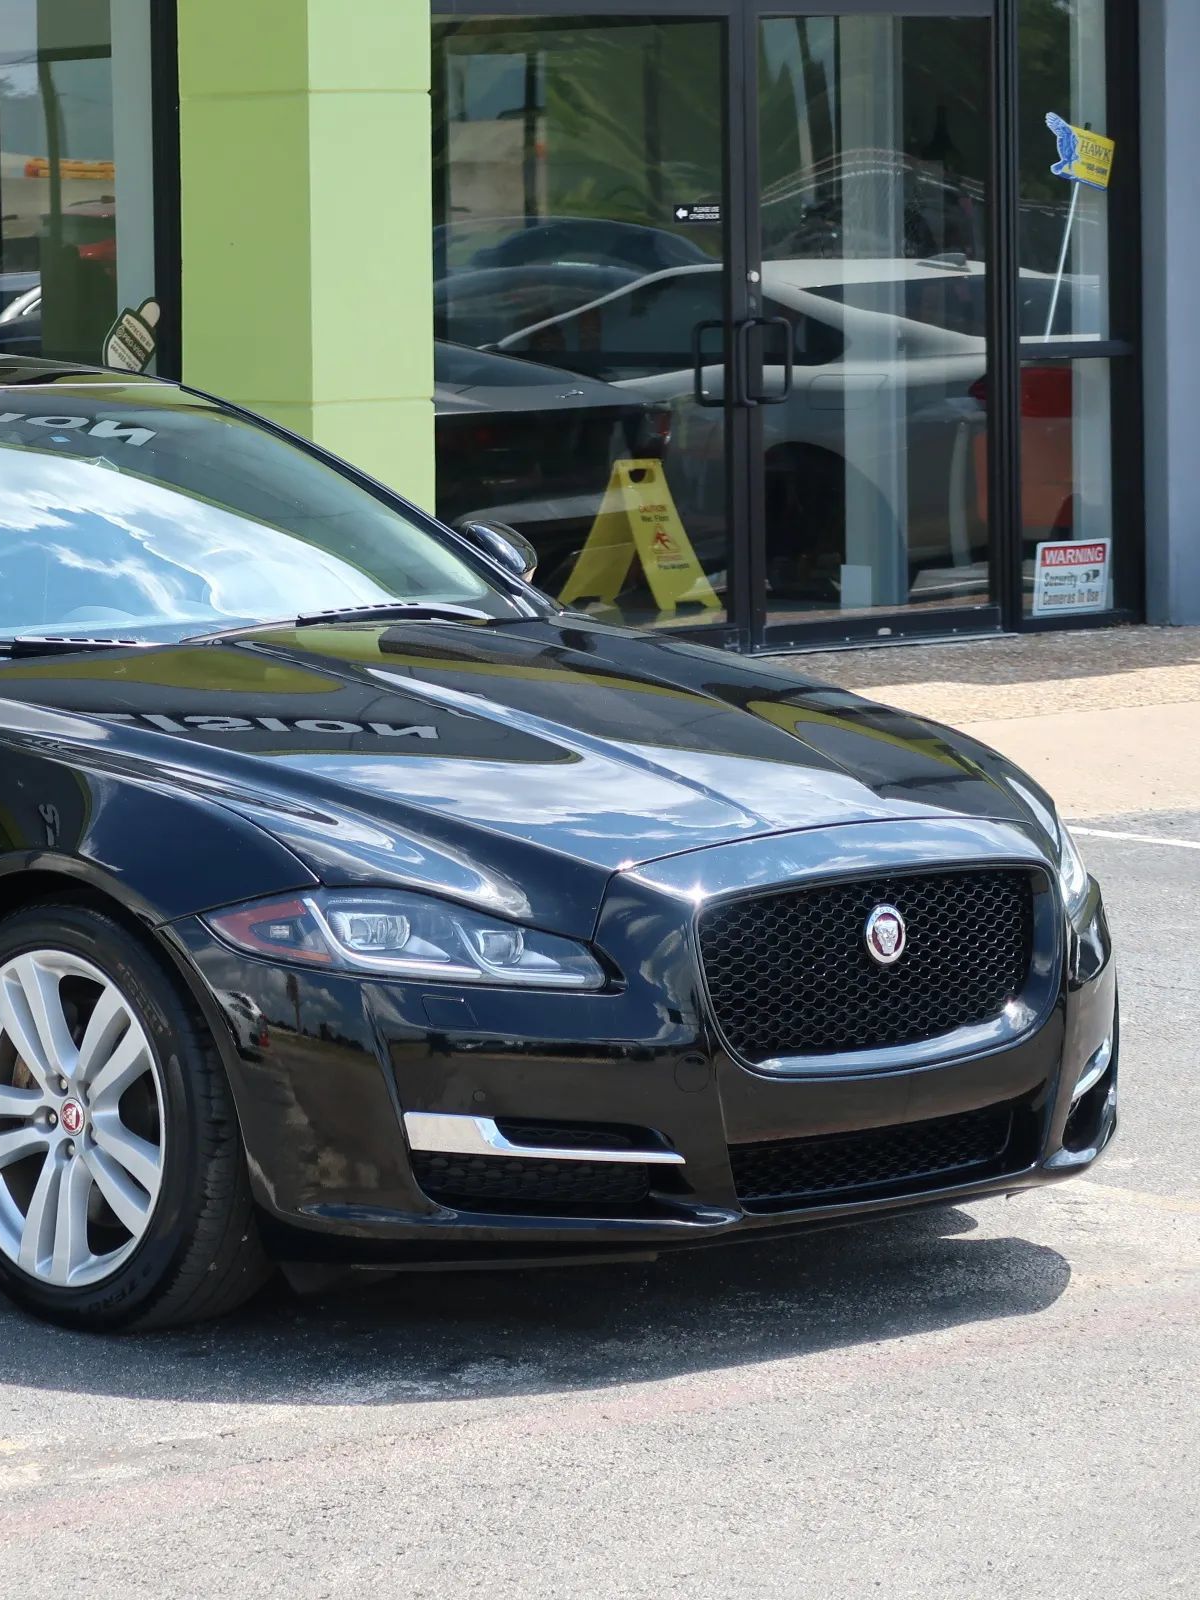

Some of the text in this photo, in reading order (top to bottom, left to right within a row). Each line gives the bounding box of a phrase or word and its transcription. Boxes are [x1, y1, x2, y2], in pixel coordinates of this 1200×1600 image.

[1080, 140, 1111, 162] HAWK
[1045, 546, 1104, 564] WARNING
[1044, 572, 1078, 588] Security
[1043, 591, 1076, 606] Cameras
[1087, 588, 1100, 602] Use
